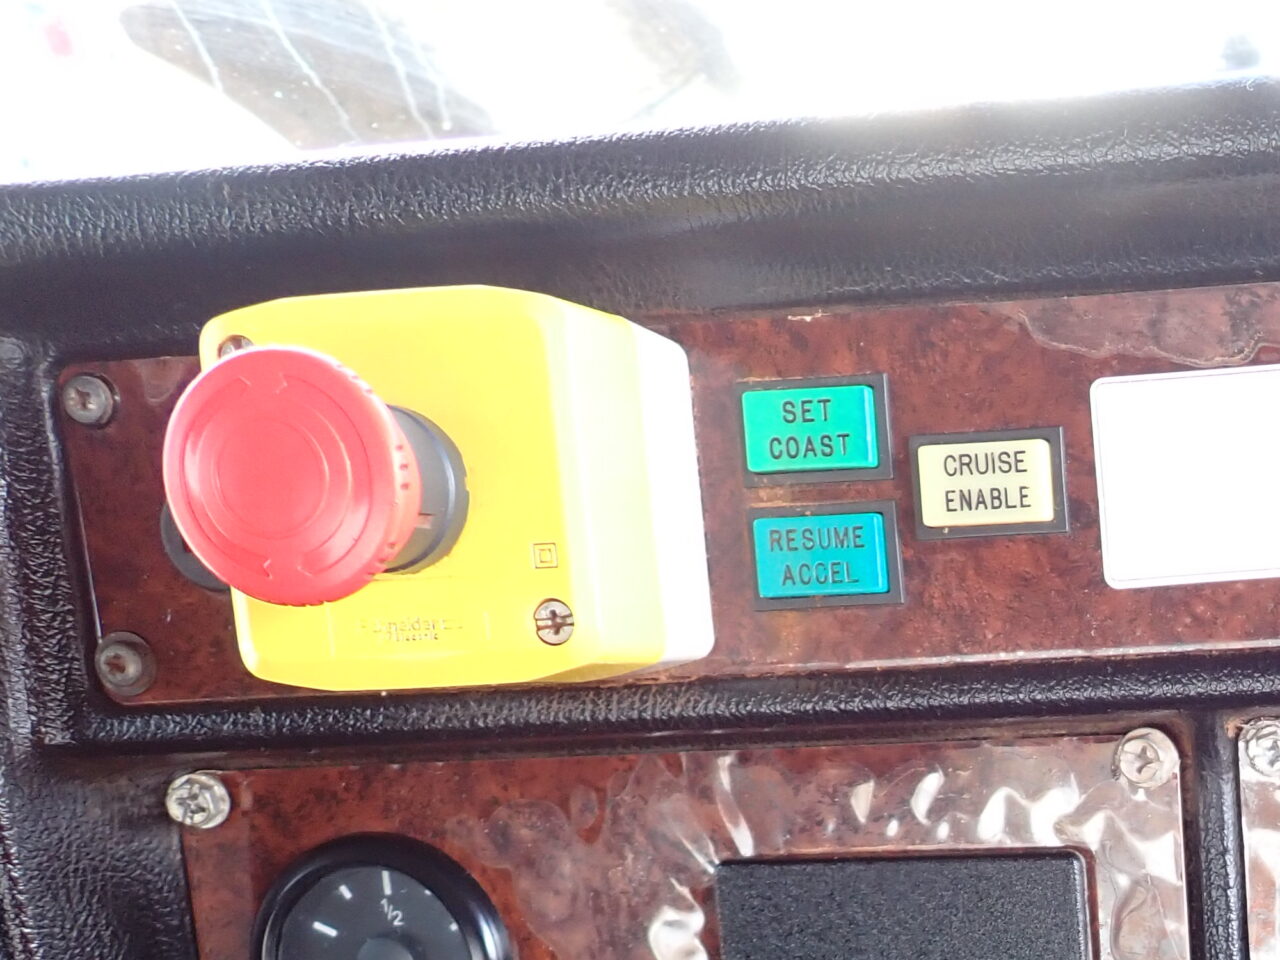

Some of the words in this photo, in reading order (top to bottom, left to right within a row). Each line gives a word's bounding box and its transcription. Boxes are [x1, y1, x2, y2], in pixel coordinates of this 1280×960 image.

[782, 399, 832, 424] SET
[768, 434, 850, 460] COAST
[943, 451, 1028, 477] CRUISE
[944, 486, 1032, 512] ENABLE
[768, 526, 866, 553] RESUME
[780, 562, 859, 586] ACCEL
